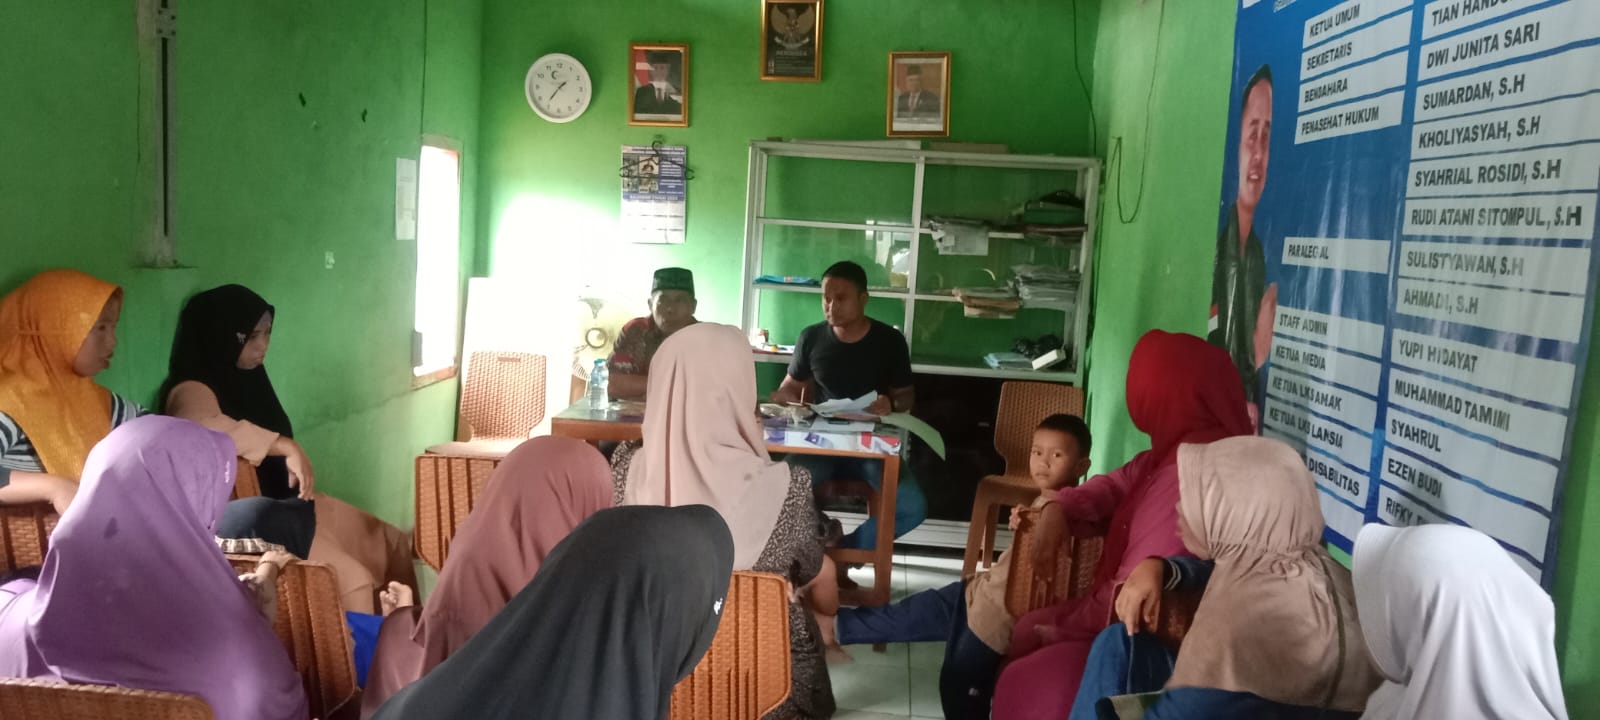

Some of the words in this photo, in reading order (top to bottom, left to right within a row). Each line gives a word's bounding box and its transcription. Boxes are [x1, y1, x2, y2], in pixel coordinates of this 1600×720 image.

[1309, 17, 1333, 38] KETUA
[1334, 6, 1361, 28] UMUM
[1431, 3, 1460, 27] TIAN
[1306, 42, 1353, 71] SEKRETARIS
[1426, 50, 1450, 70] DWI
[1452, 30, 1500, 62] JUNITA
[1503, 21, 1541, 49] SARI
[1422, 83, 1496, 111] SUMARDAN,
[1498, 73, 1526, 97] S.H
[1301, 113, 1344, 136] PENASEHAT
[1344, 106, 1380, 126] HUKUM
[1418, 120, 1513, 149] KHOLIYASYAH,
[1515, 115, 1541, 138] S.H
[1414, 164, 1473, 187] SYAHRIAL
[1477, 162, 1528, 185] ROSIDI,
[1530, 159, 1562, 181] S.H
[1411, 209, 1437, 226] RUDI
[1438, 208, 1475, 226] ATANI
[1477, 207, 1552, 231] SITOMPUL,
[1553, 205, 1583, 227] S.H
[1406, 250, 1497, 278] SULISTYAWAN,
[1499, 256, 1525, 276] S.H
[1403, 288, 1453, 314] AHMADI,
[1455, 295, 1479, 314] S.H
[1278, 313, 1301, 330] STAFF
[1301, 317, 1328, 336] ADMIN
[1274, 344, 1301, 366] KETUA
[1301, 349, 1326, 371] MEDIA
[1399, 339, 1424, 360] YUPI
[1426, 344, 1478, 373] HIDAYAT
[1272, 376, 1299, 397] KETUA
[1394, 378, 1462, 416] MUHAMMAD
[1269, 405, 1296, 428] KETUA
[1311, 424, 1344, 449] LANSIA
[1390, 418, 1442, 453] SYAHRUL
[1308, 457, 1360, 497] DISABILITAS
[1387, 458, 1417, 485] EZEN
[1417, 465, 1443, 499] BUDI
